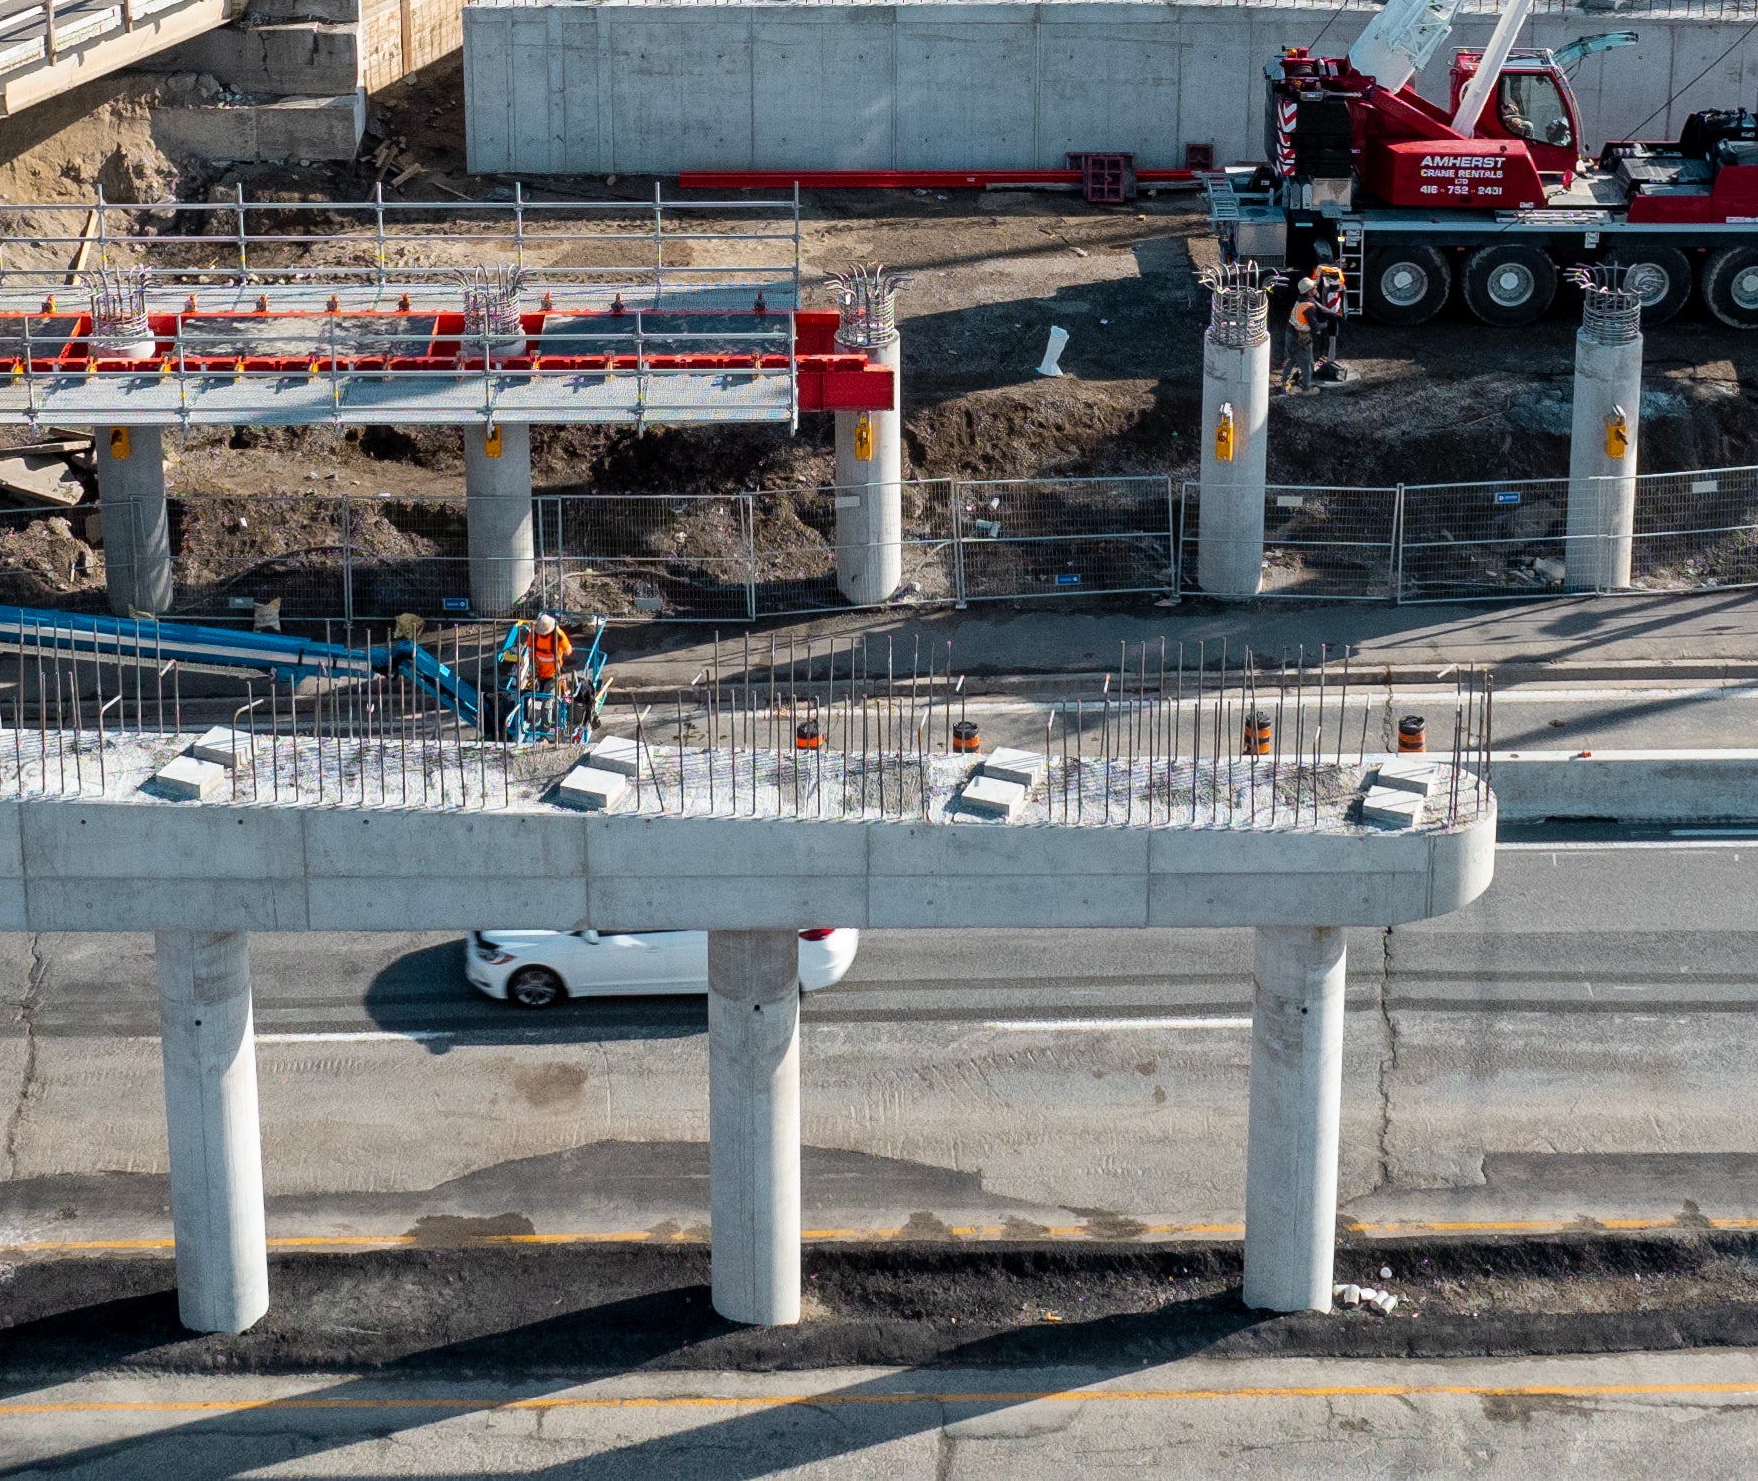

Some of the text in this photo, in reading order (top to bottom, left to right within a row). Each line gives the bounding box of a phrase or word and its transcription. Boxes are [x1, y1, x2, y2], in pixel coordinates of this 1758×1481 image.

[1420, 155, 1506, 168] AMHERST
[1420, 169, 1503, 178] CRANE RENTALS
[1420, 185, 1438, 194] 416
[1447, 186, 1469, 195] 752
